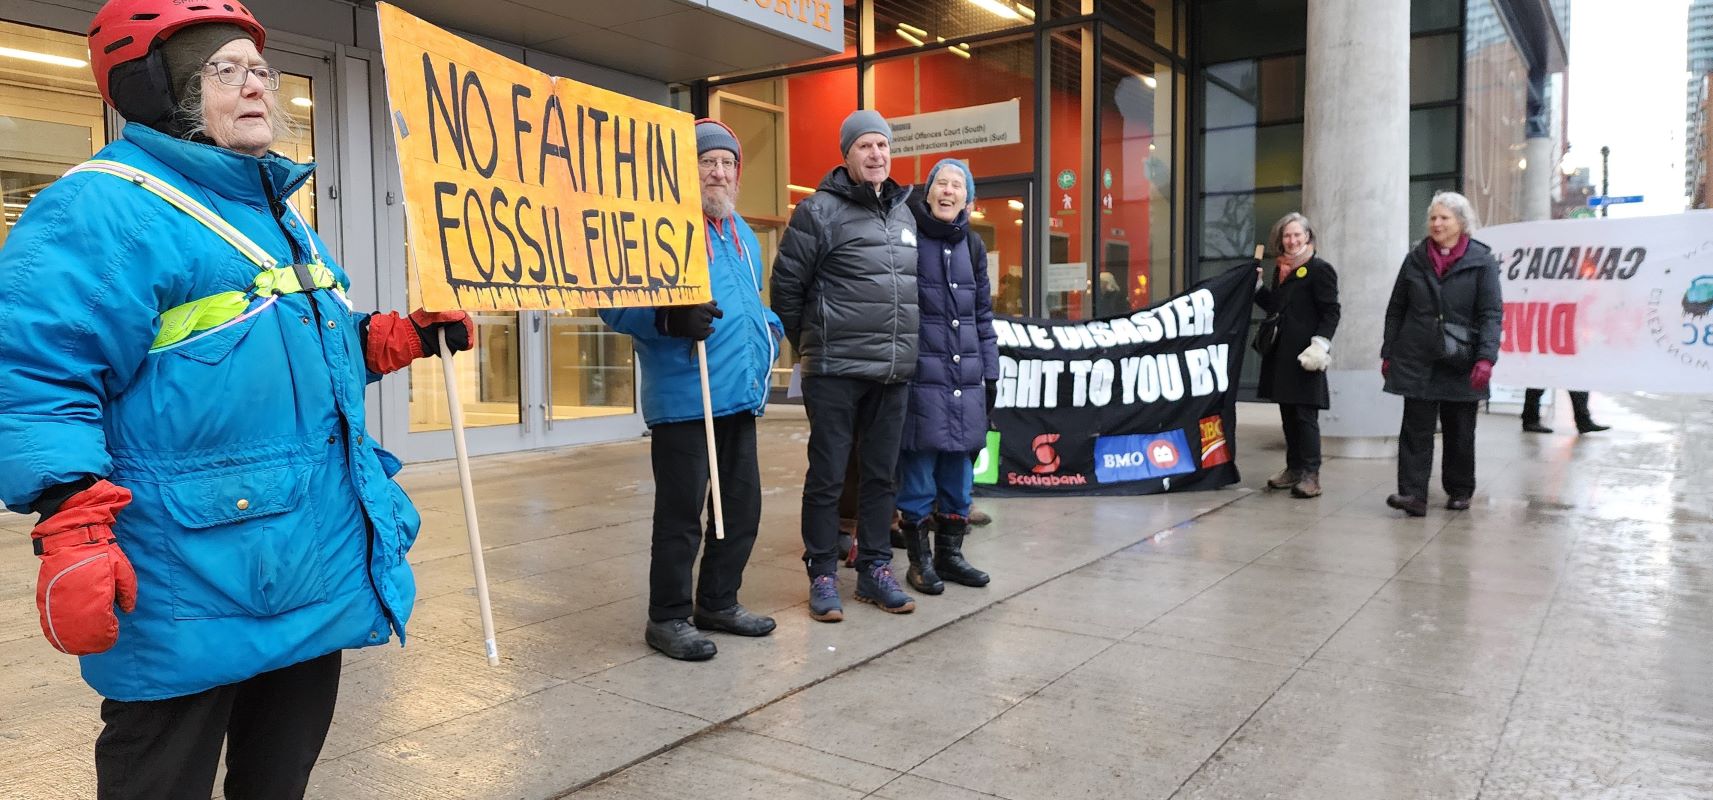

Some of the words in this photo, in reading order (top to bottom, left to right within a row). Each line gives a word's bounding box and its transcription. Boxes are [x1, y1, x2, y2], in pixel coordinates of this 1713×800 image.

[744, 0, 832, 32] RTH
[423, 52, 498, 179] NO
[512, 83, 638, 202] FAITH
[647, 121, 681, 204] IN
[943, 127, 961, 137] Court
[962, 123, 986, 136] (South)
[903, 144, 914, 152] des
[916, 141, 948, 151] infractions
[990, 132, 1007, 142] (Sud)
[434, 181, 578, 286] FOSSIL
[582, 208, 694, 287] FUELS!
[1070, 358, 1115, 407] TO
[1120, 355, 1185, 404] YOU
[1184, 344, 1229, 397] BY
[1103, 451, 1144, 468] BMO
[1007, 472, 1088, 486] Scotiabank
